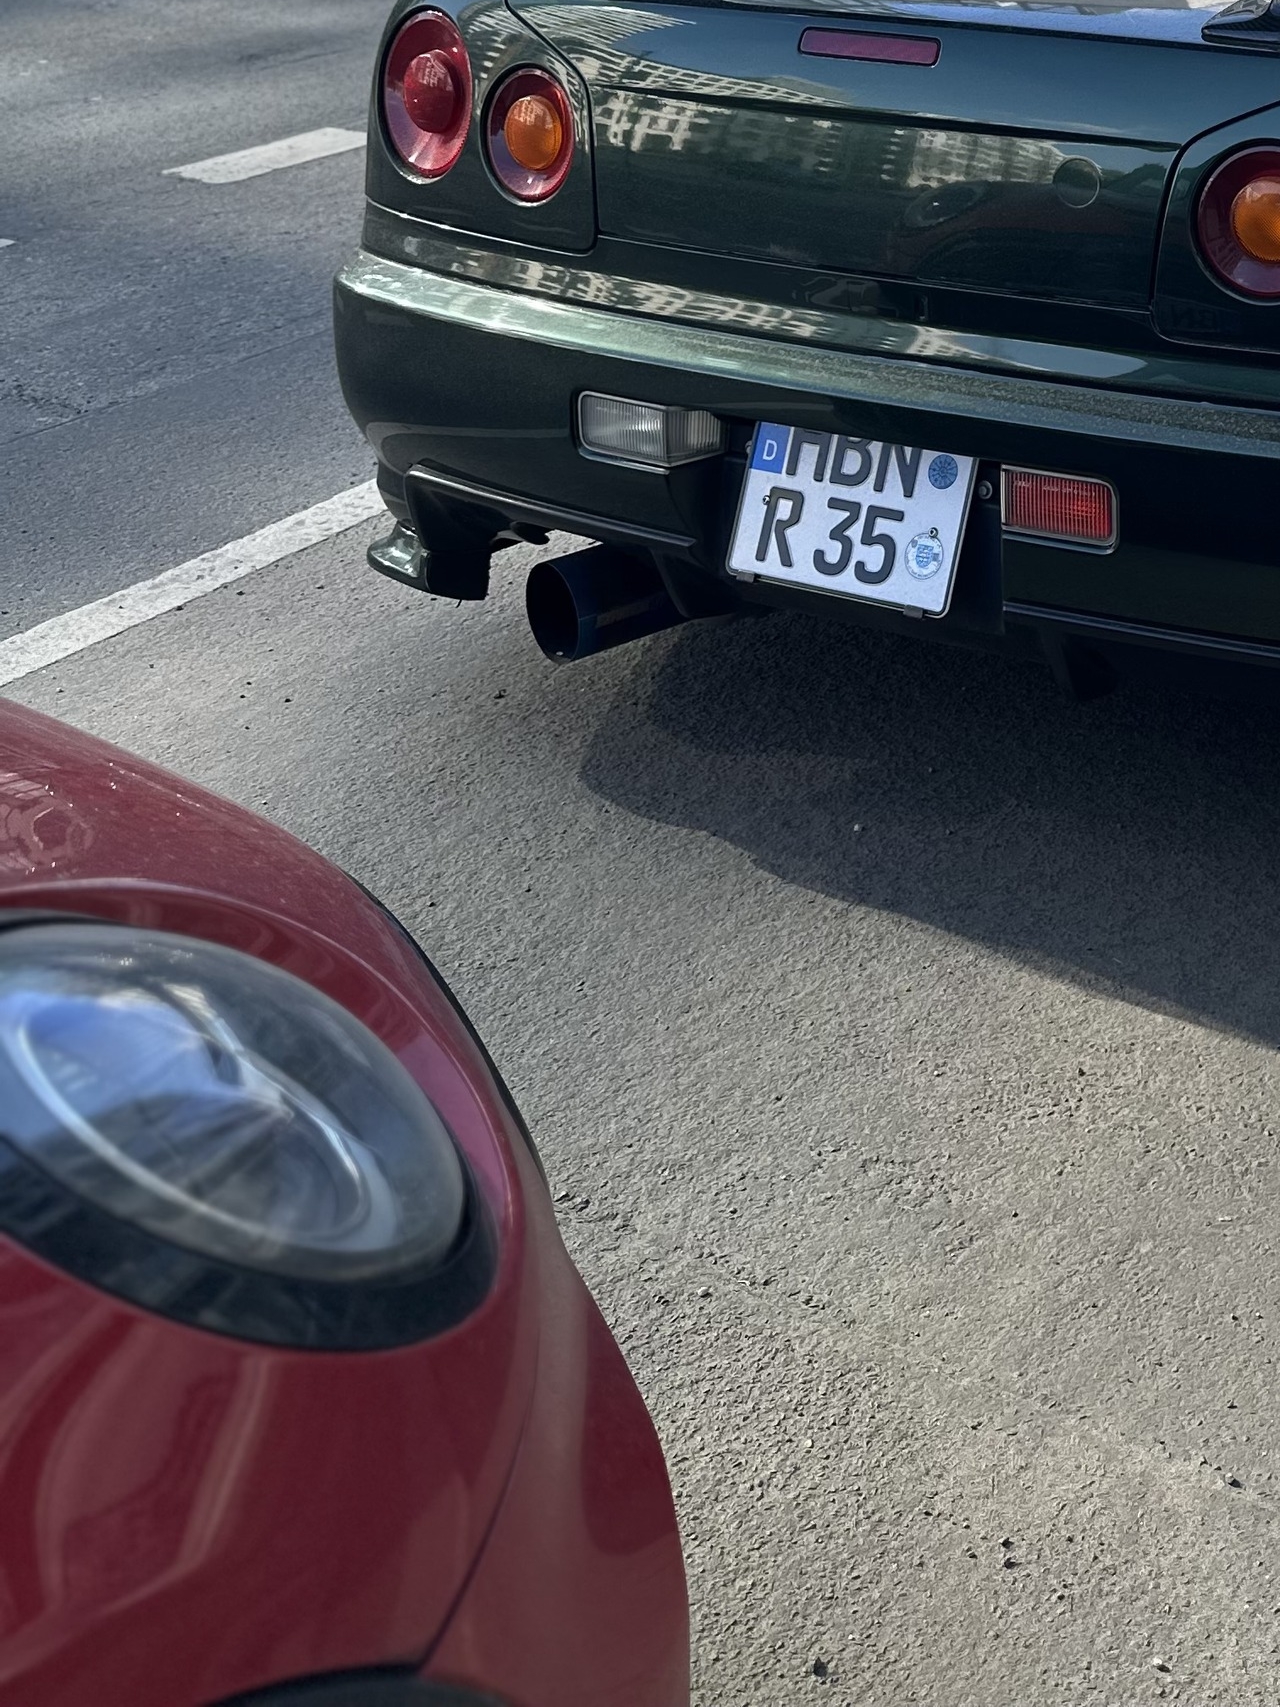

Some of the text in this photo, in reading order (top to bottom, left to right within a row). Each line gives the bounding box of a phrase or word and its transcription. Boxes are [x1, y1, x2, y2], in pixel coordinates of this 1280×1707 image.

[762, 439, 777, 461] D
[785, 426, 923, 498] HBN
[755, 486, 805, 568] R
[813, 497, 906, 585] 35
